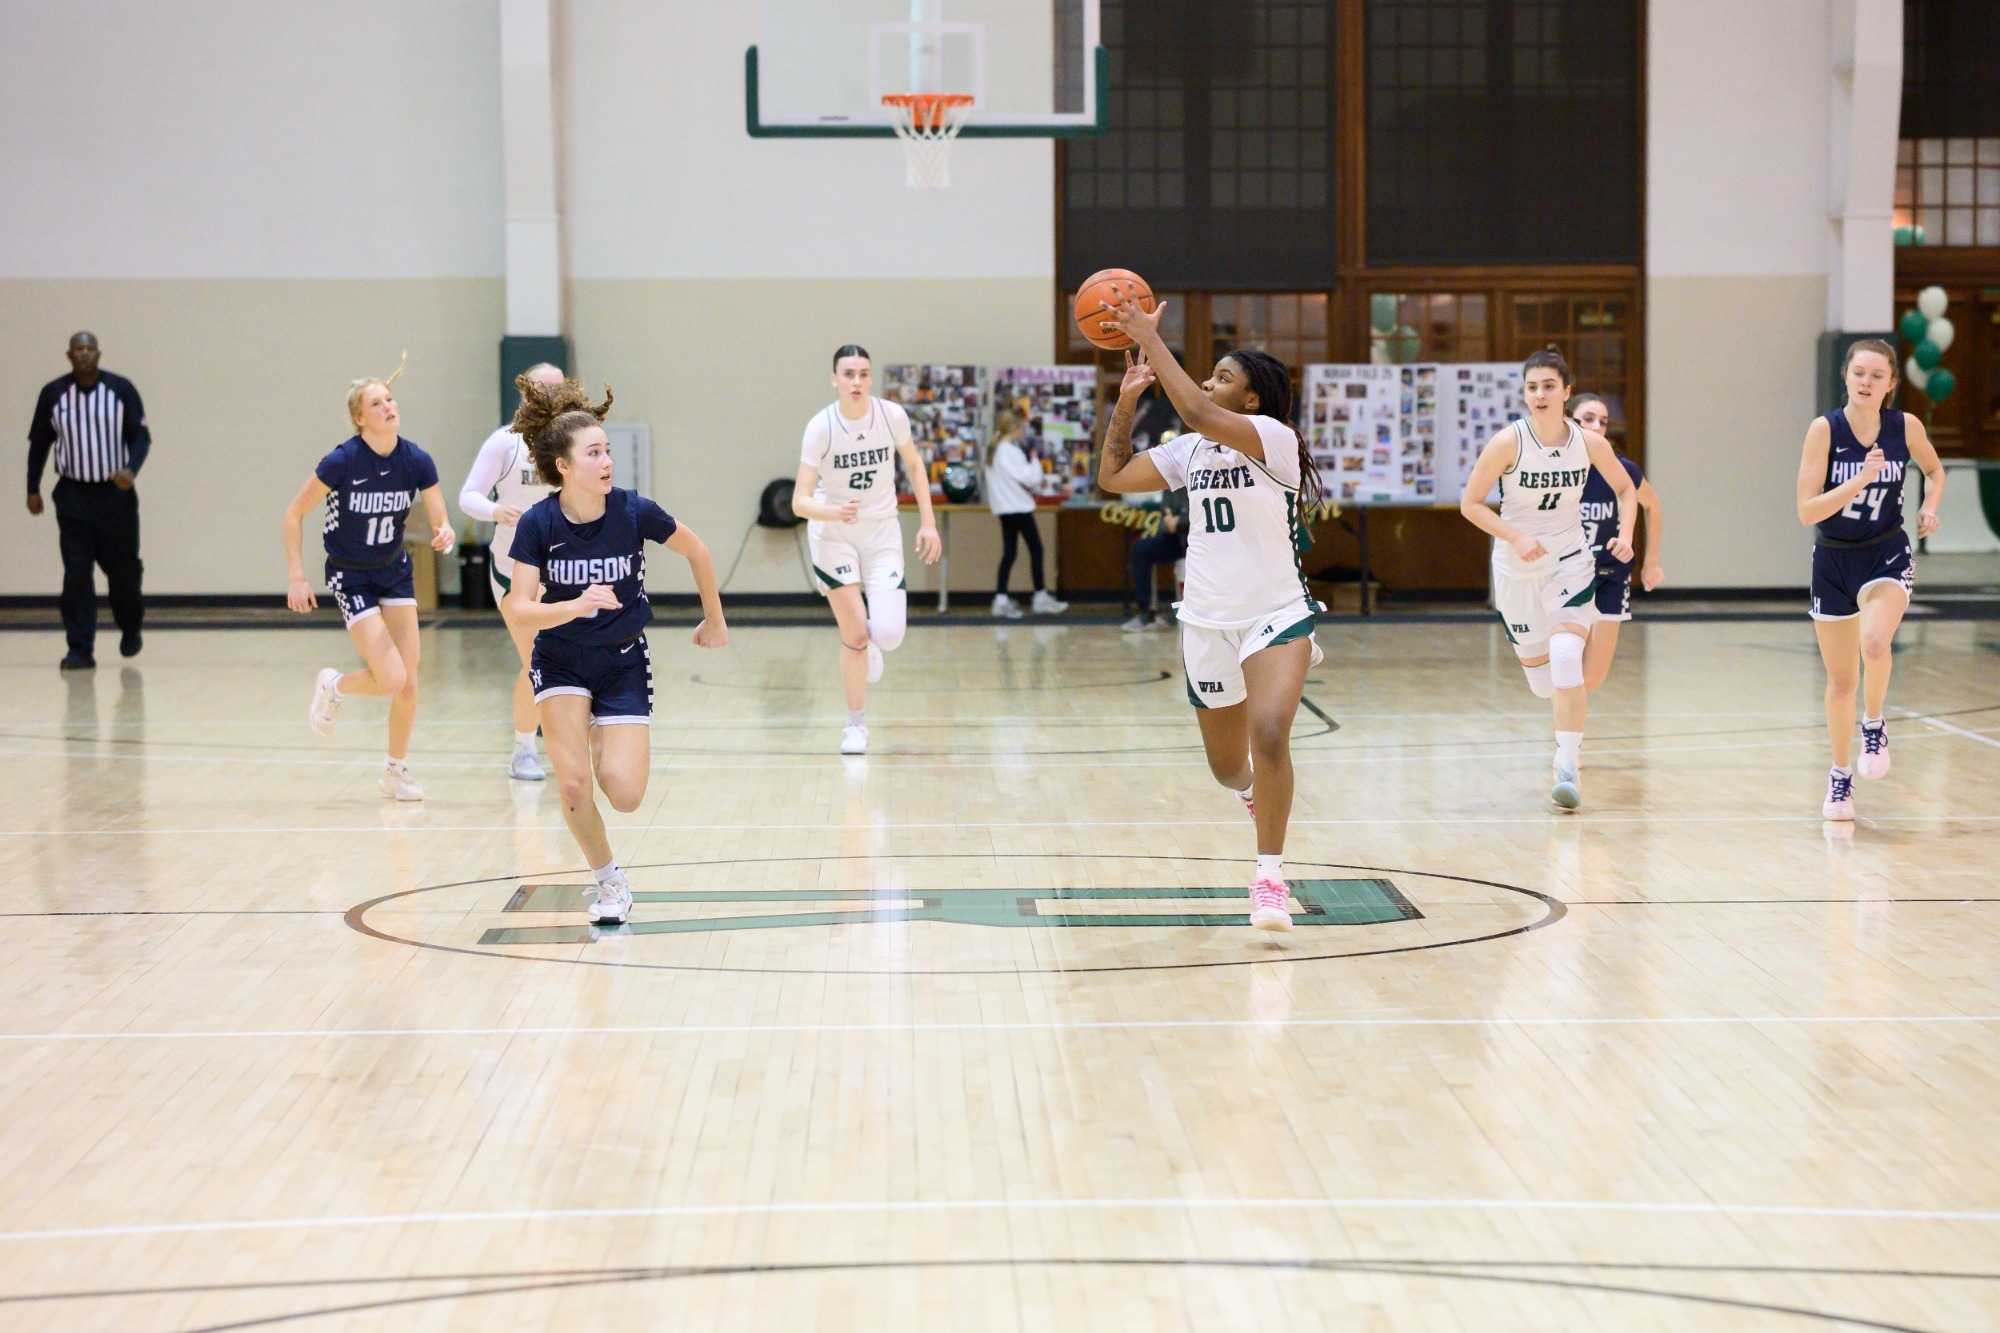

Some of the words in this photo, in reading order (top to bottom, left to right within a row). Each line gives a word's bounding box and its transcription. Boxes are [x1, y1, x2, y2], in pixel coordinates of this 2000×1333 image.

[849, 470, 877, 490] 25
[1519, 468, 1587, 489] RESERVE
[1830, 461, 1904, 483] HUON
[348, 490, 412, 514] HUDSON
[1538, 492, 1562, 511] 11
[1580, 501, 1614, 521] SON
[1841, 488, 1888, 521] 24
[1202, 497, 1235, 533] 10
[366, 516, 395, 546] 10
[547, 554, 633, 585] HUDSON
[352, 594, 366, 610] H
[1511, 623, 1531, 634] WRA
[1197, 681, 1225, 693] WRA
